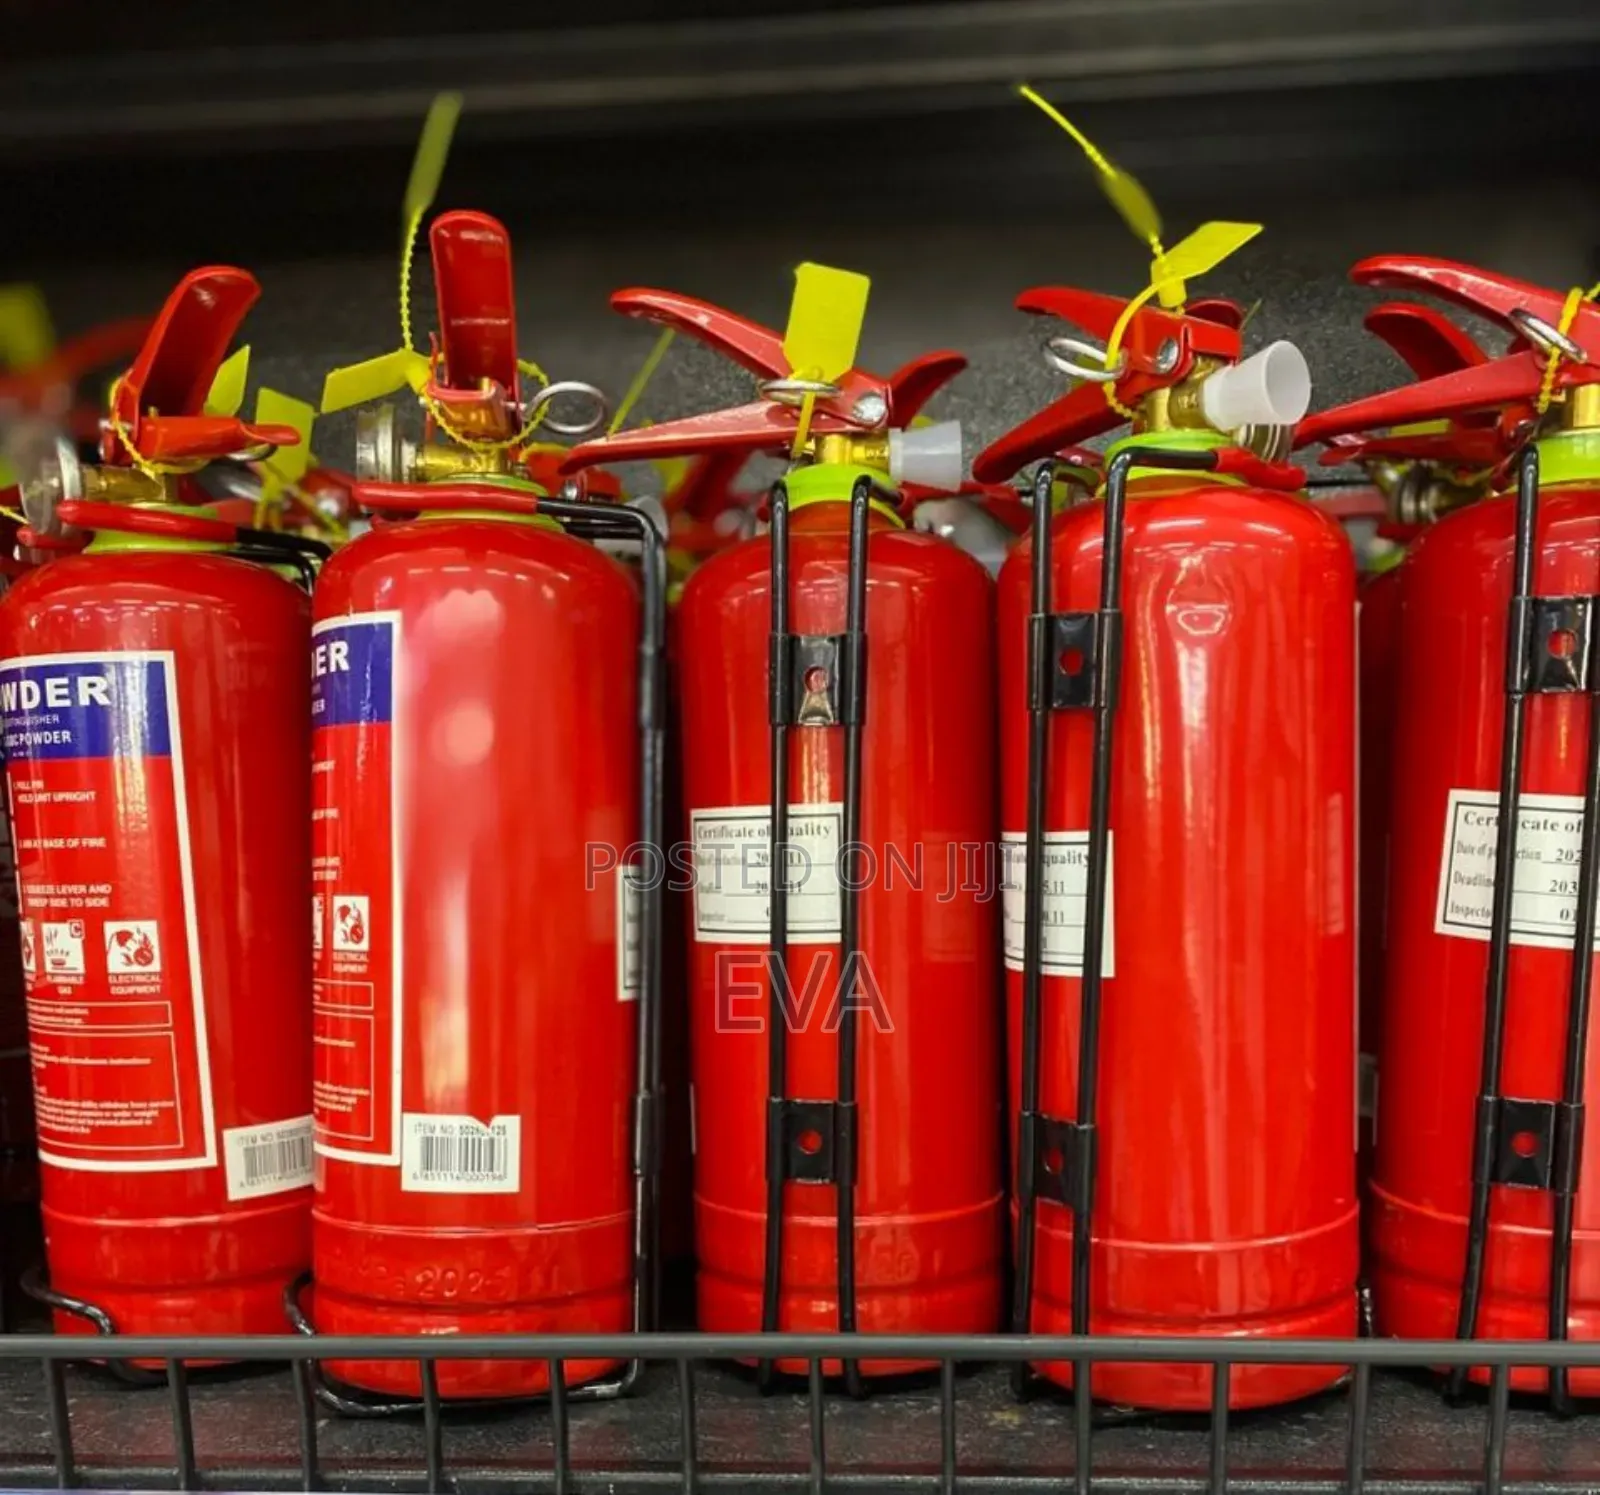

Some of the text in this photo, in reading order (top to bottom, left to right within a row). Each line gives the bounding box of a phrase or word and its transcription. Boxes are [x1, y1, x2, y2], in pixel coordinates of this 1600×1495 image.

[312, 641, 350, 677] ER
[19, 730, 72, 746] POWDER
[66, 838, 80, 848] OF
[88, 884, 112, 894] AND
[70, 897, 84, 907] TO
[108, 974, 162, 984] ELECTRICAL
